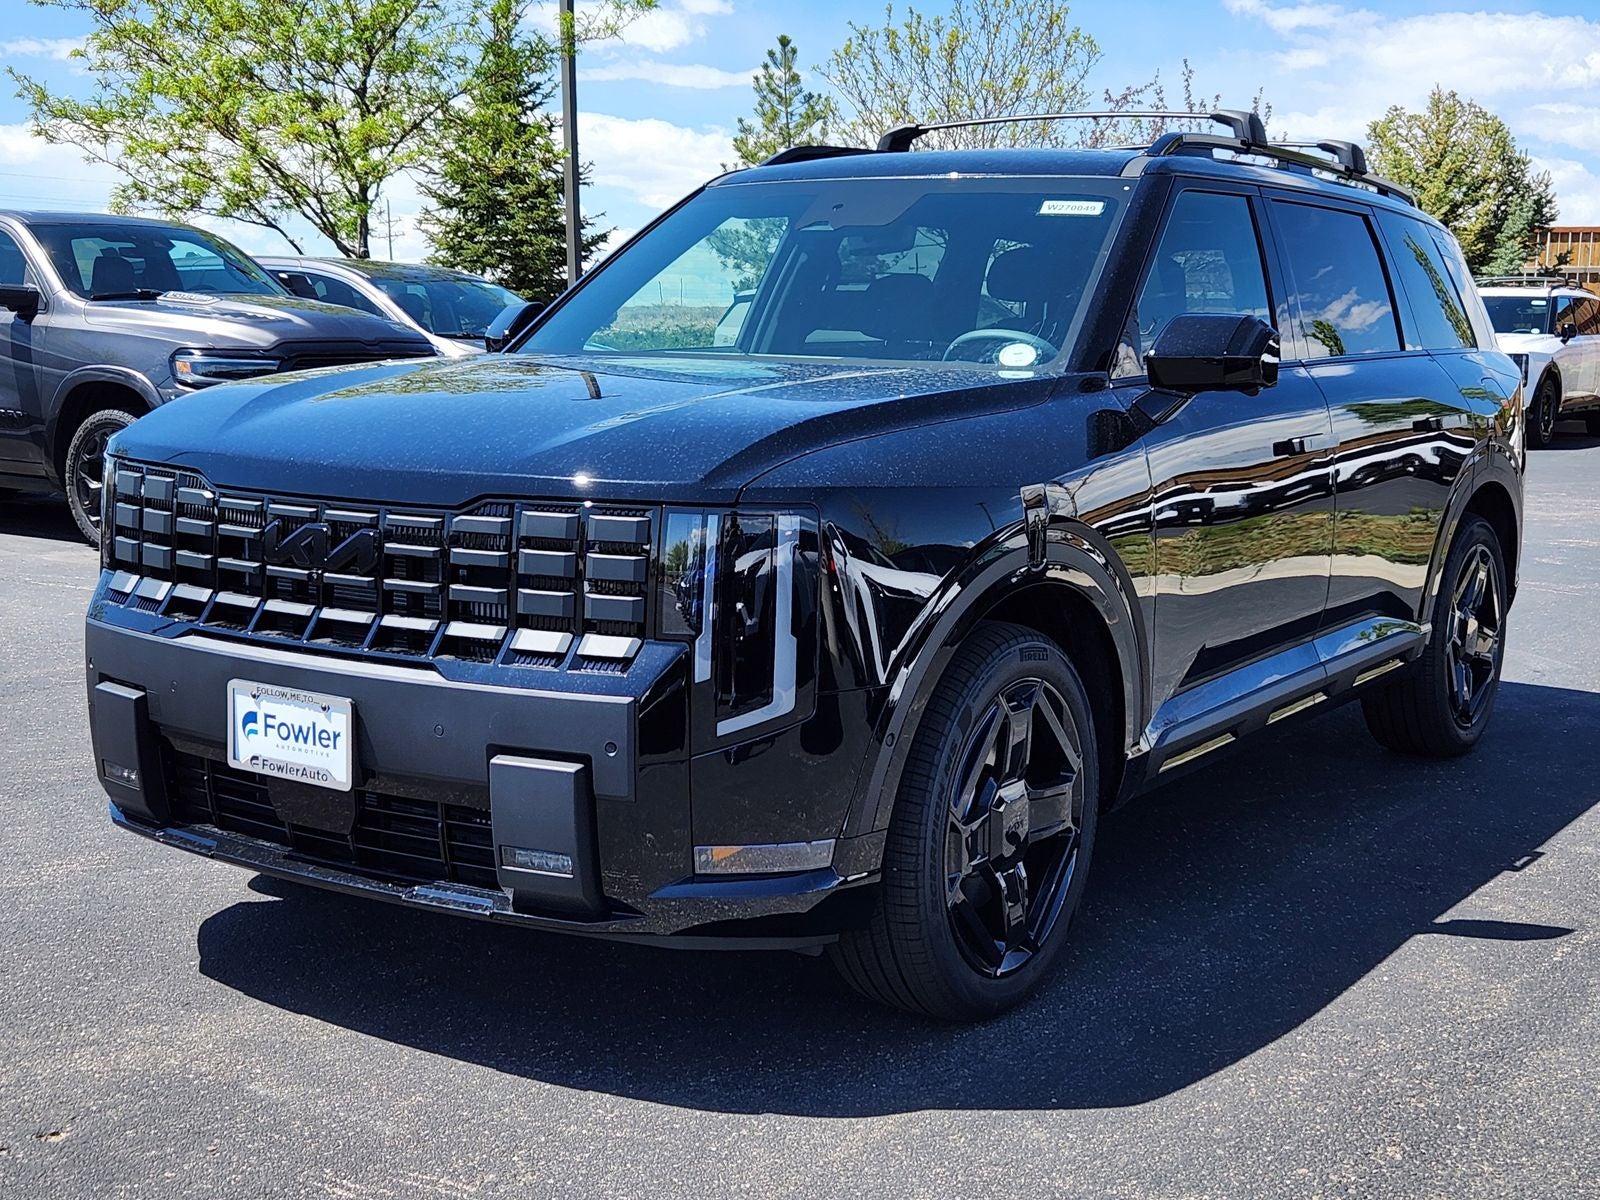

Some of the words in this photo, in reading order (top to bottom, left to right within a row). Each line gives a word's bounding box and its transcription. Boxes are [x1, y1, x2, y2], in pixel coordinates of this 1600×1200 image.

[1047, 204, 1096, 212] W270049
[256, 686, 288, 699] FOLLOW
[290, 692, 301, 702] ME
[264, 713, 341, 750] Fowler
[276, 743, 330, 758] AUTOMOTIVE
[262, 759, 328, 782] FowlerAuto
